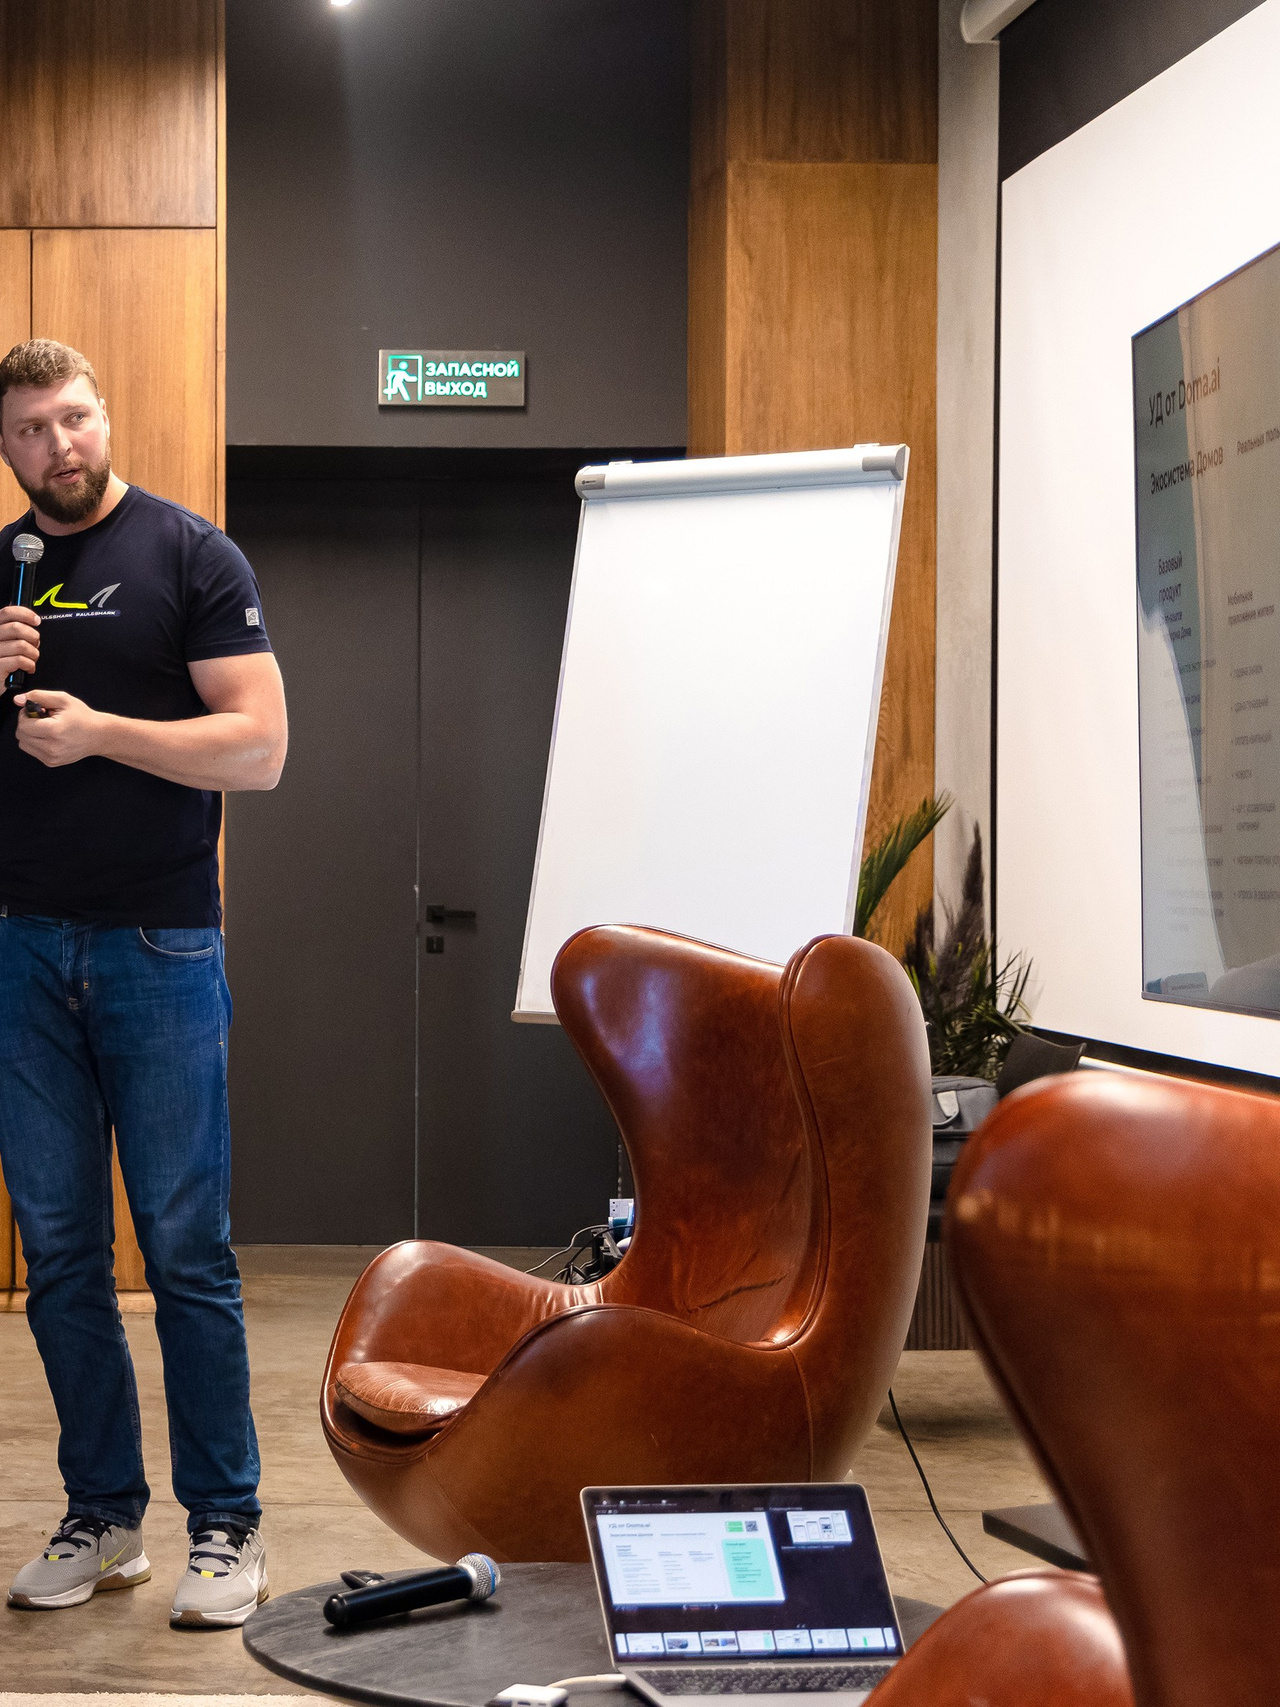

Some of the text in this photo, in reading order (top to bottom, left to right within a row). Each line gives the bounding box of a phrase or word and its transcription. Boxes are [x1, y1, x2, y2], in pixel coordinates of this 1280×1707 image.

[425, 360, 519, 377] ЗАПАСНОЙ
[425, 382, 487, 399] ВЫХОД
[1148, 356, 1220, 428] УД от Doma.ai
[1150, 446, 1224, 495] Экосистема Домов
